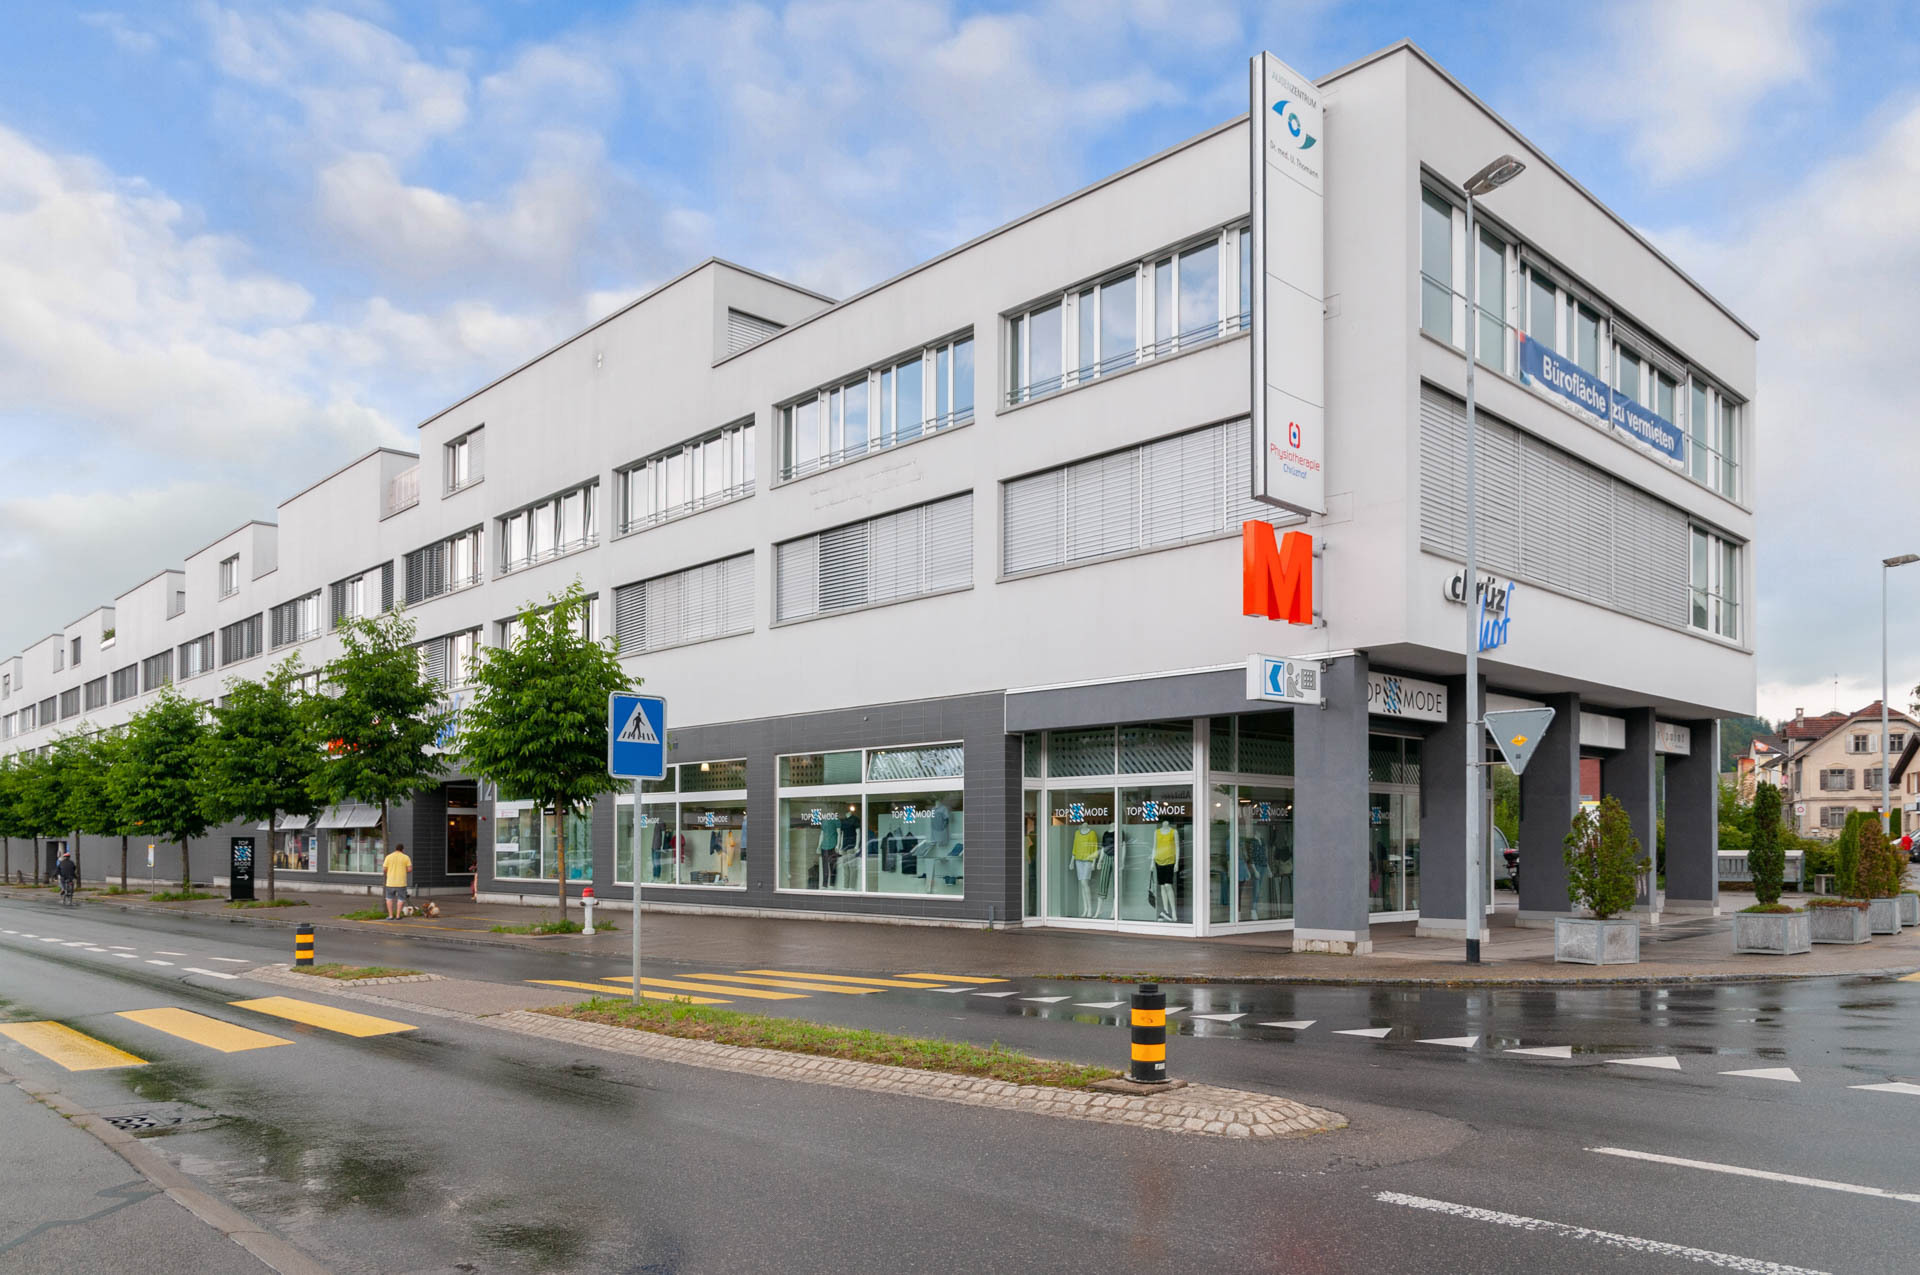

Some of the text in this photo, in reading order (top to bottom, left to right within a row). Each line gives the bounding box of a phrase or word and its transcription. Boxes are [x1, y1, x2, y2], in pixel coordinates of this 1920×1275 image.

[1542, 355, 1606, 413] Bürofläche
[1612, 403, 1625, 424] zu
[1627, 410, 1675, 452] vermieten
[1270, 441, 1320, 472] Physiotherapie
[1243, 519, 1313, 625] M
[1403, 688, 1442, 713] MODE
[801, 812, 839, 821] TOP MODE
[891, 809, 935, 819] TOP MODE
[1055, 807, 1108, 817] TOP MODE
[1127, 805, 1185, 816] TOP MODE
